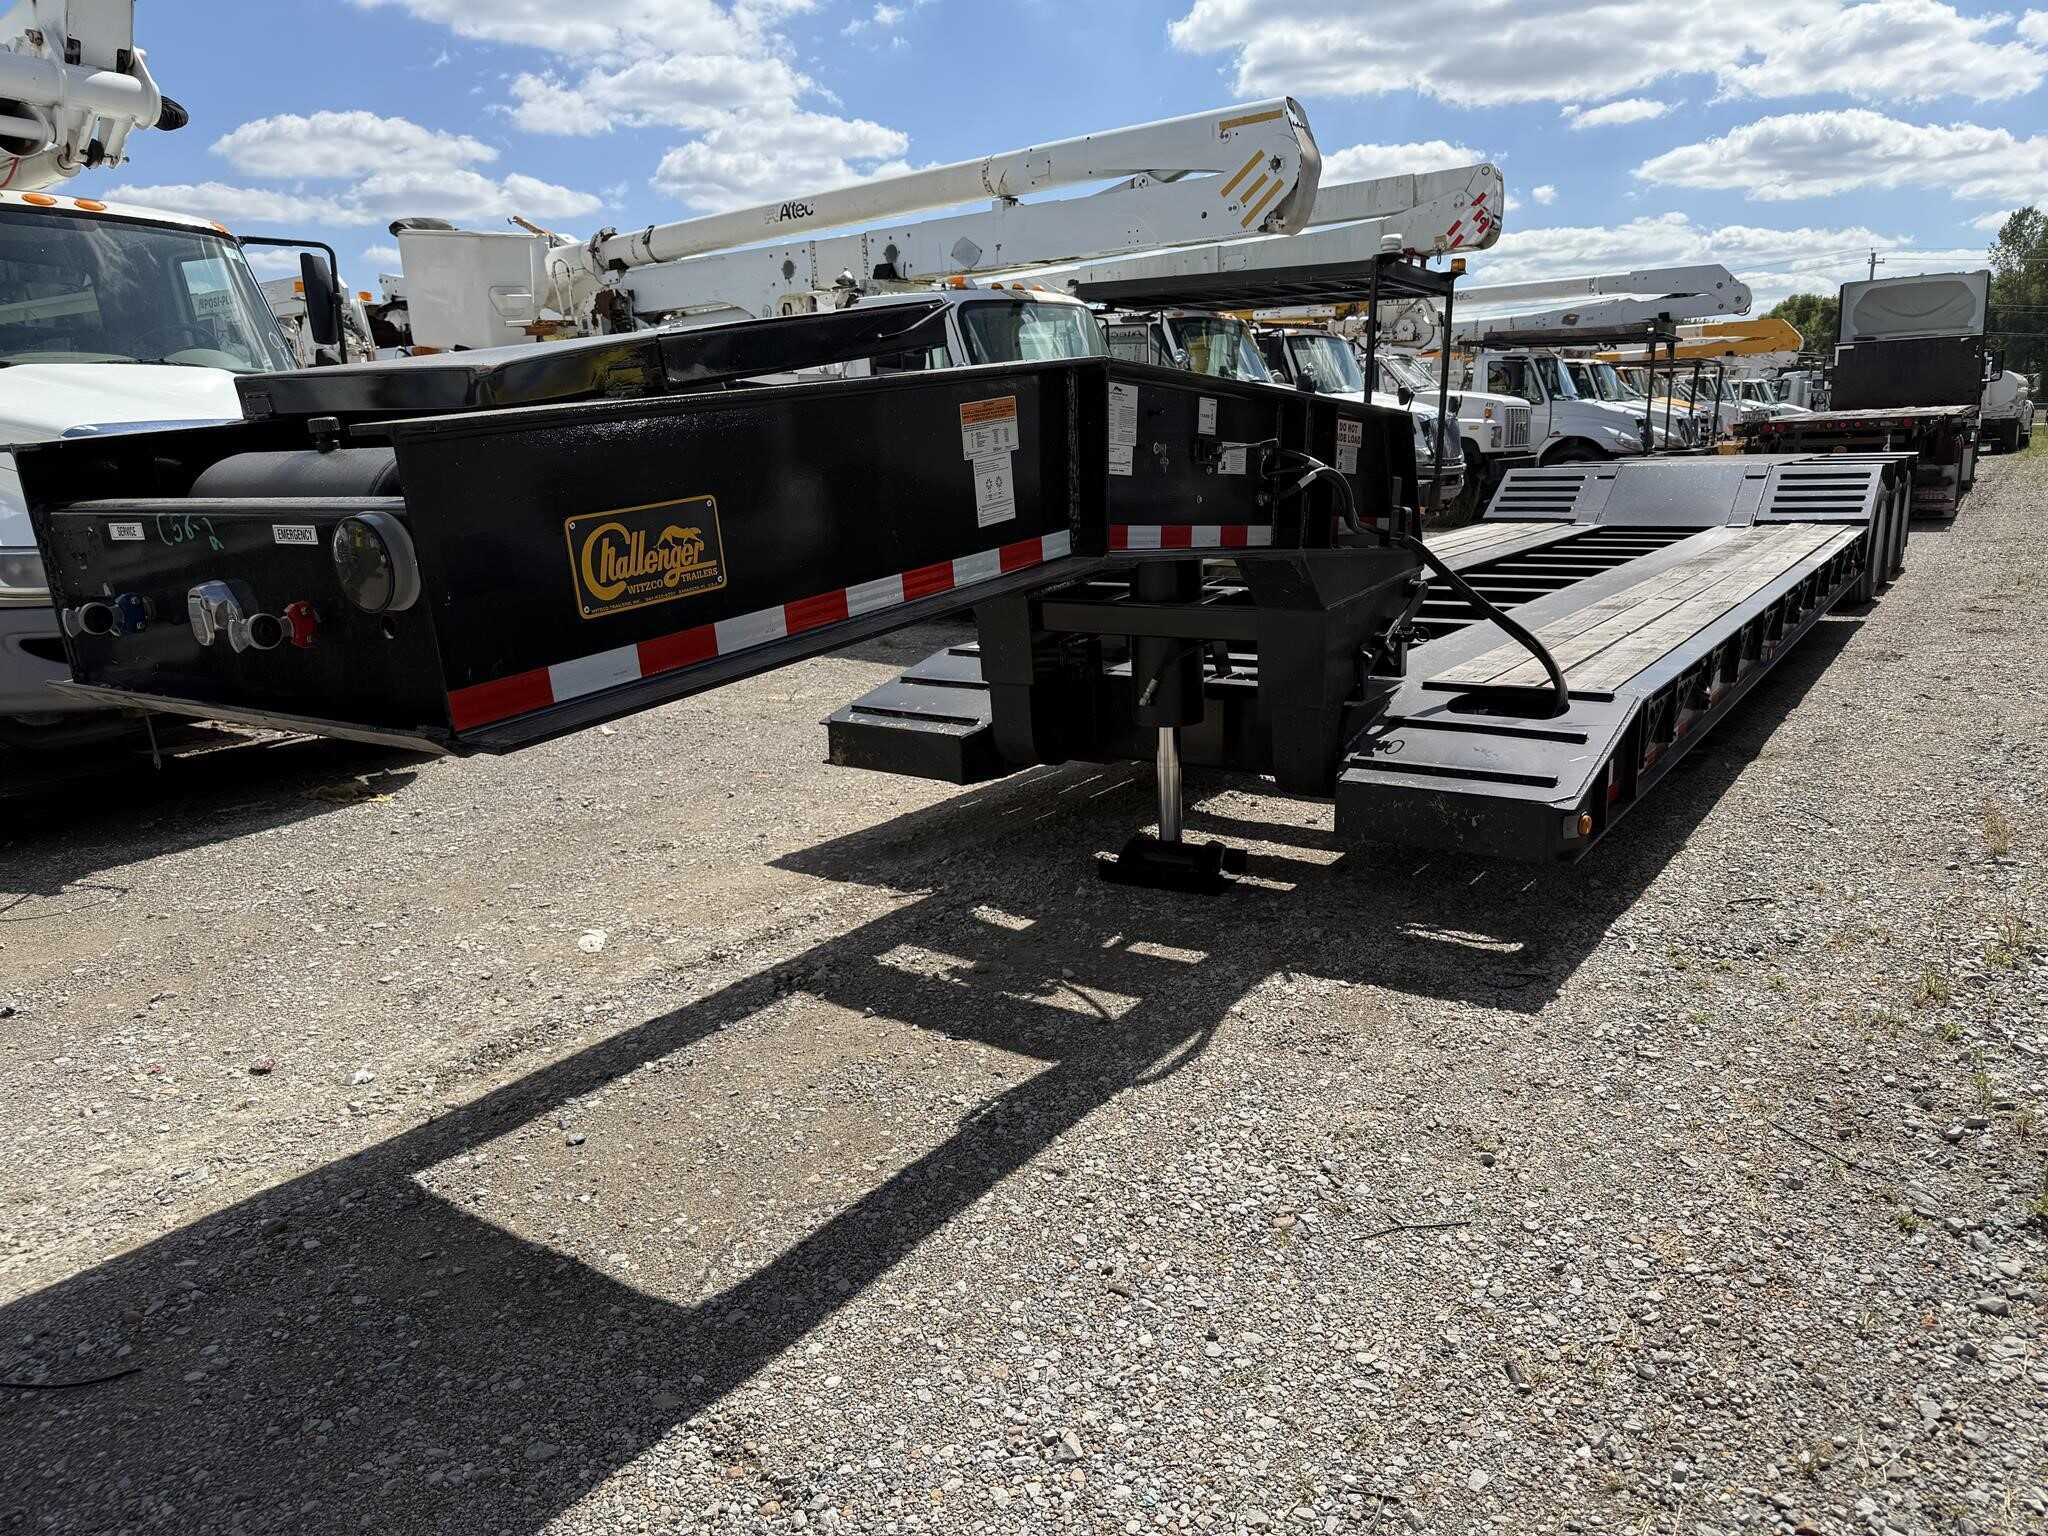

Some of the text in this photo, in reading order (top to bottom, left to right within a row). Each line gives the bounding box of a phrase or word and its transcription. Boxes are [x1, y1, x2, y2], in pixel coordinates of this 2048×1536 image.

[779, 201, 814, 221] Altec
[1339, 421, 1359, 433] DO NOT
[1337, 432, 1361, 445] IDE LOAD
[117, 526, 137, 537] SERVICE
[277, 528, 314, 541] EMERGENCY
[581, 522, 717, 601] Challenger
[627, 578, 664, 595] WITZCO
[681, 567, 718, 583] TRAILERS
